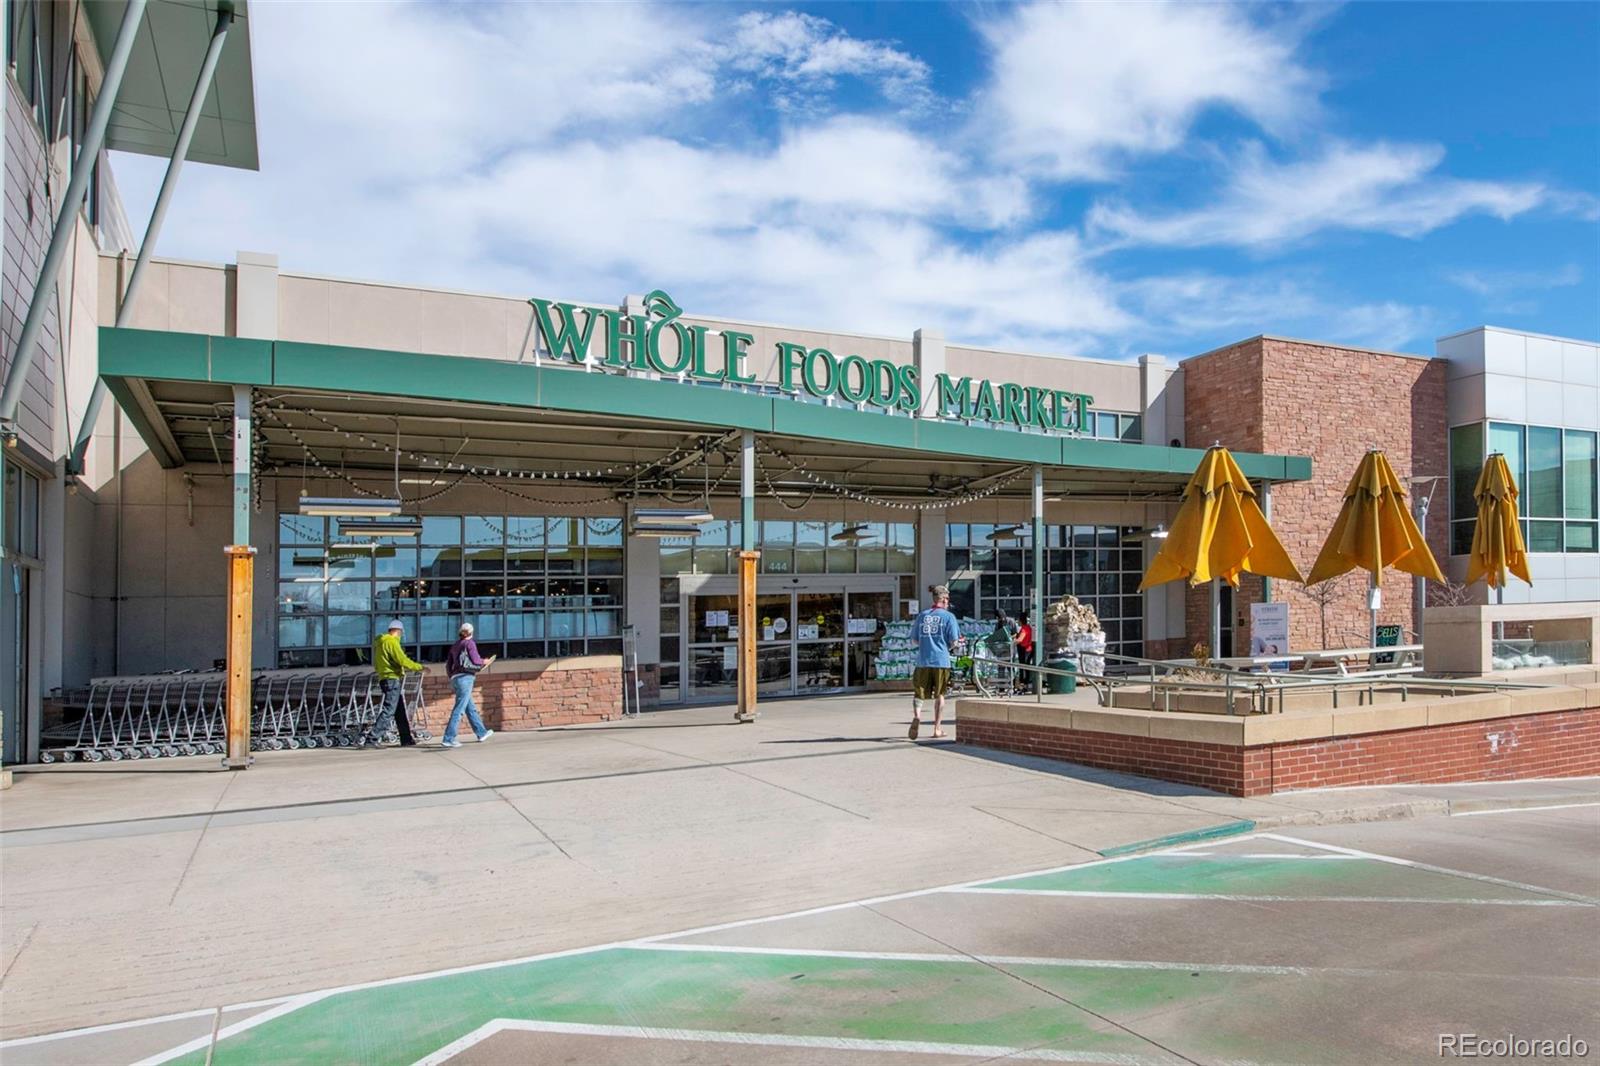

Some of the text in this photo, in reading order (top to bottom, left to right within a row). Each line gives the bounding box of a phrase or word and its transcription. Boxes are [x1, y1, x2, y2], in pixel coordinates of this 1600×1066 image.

[528, 290, 1095, 432] WHOLE FOODS MARKET
[769, 561, 787, 571] 444
